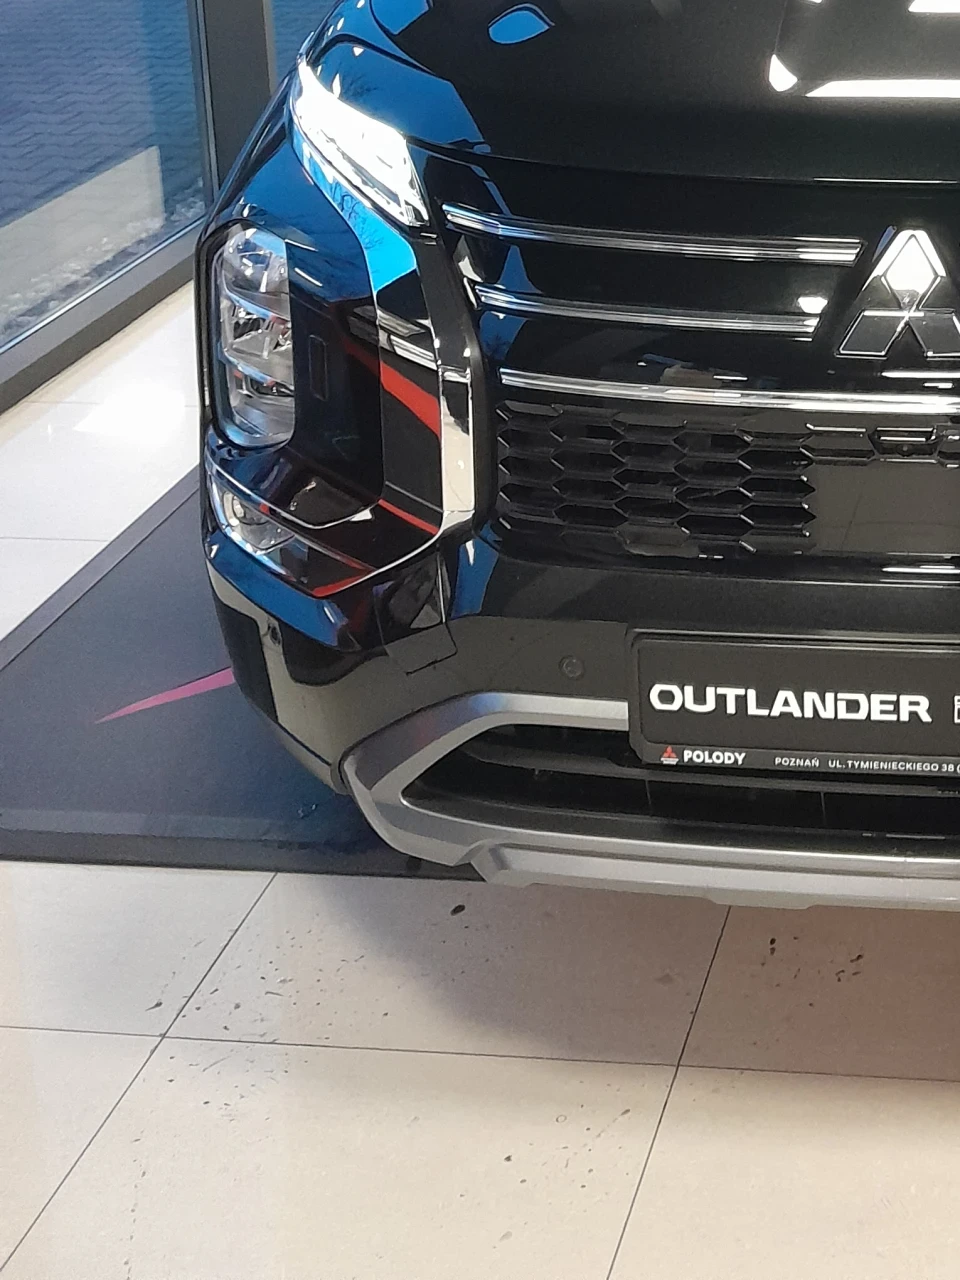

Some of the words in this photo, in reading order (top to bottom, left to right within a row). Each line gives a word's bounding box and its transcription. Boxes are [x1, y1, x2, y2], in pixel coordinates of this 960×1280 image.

[648, 683, 932, 723] OUTLANDER
[683, 749, 746, 765] POLODY
[774, 756, 820, 768] POZNAŃ
[941, 763, 955, 773] 38
